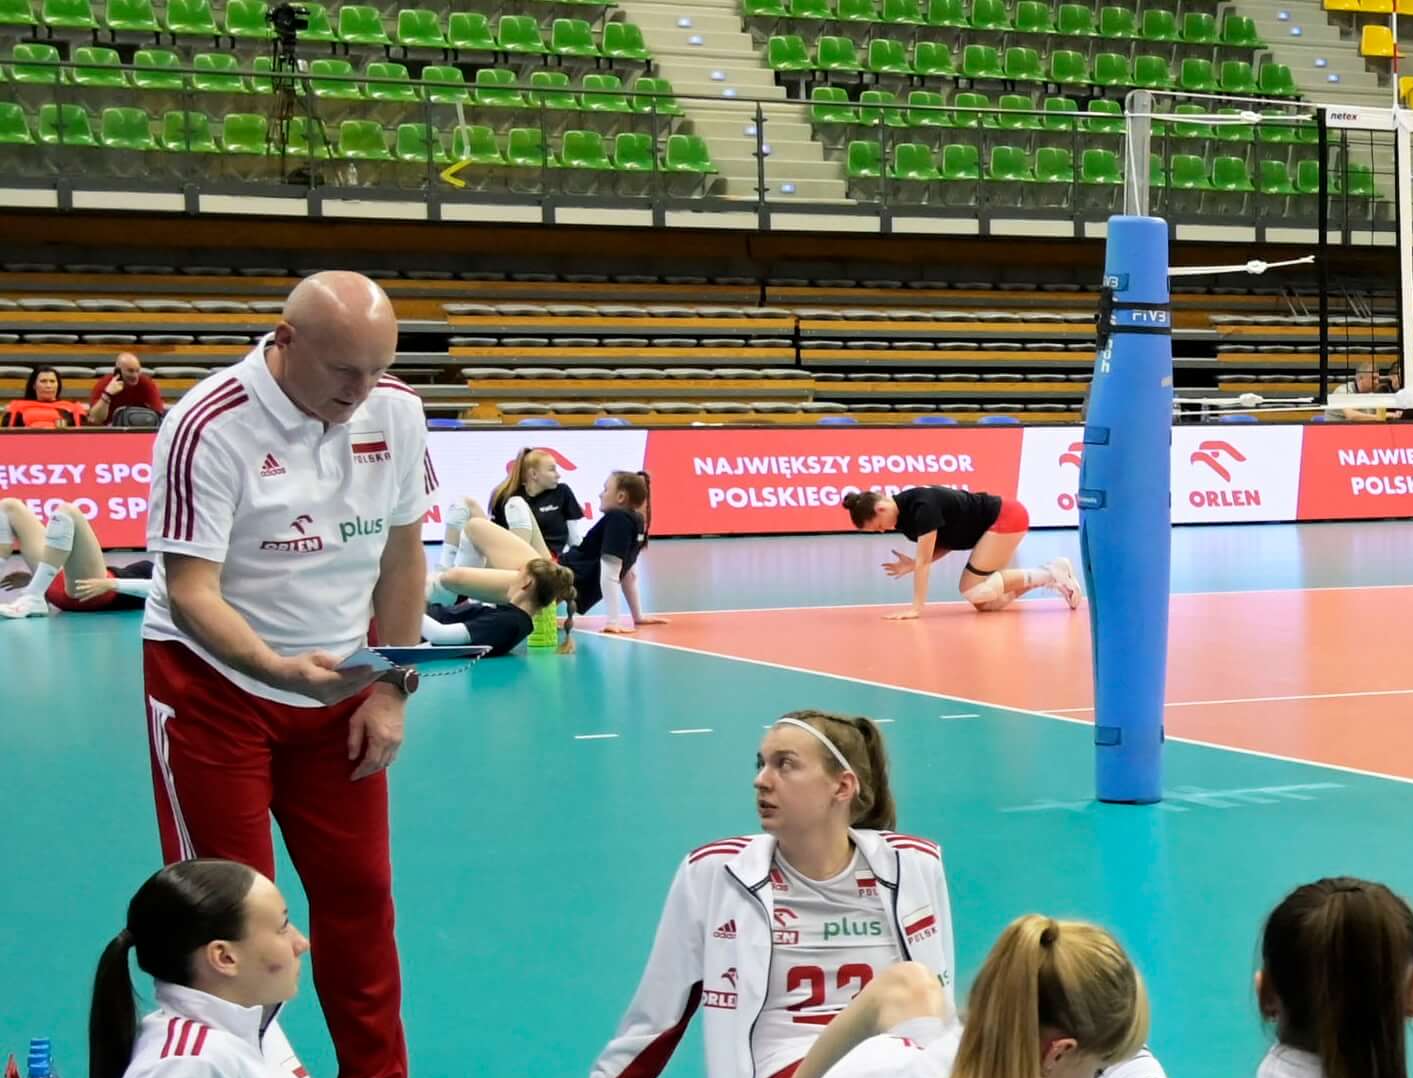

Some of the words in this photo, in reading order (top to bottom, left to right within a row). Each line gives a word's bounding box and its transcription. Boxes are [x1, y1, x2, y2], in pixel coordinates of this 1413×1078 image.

[1330, 112, 1358, 121] netex
[693, 456, 851, 479] NAJWIĘKSZY
[858, 454, 974, 473] SPONSOR
[1189, 490, 1262, 508] ORLEN
[339, 515, 383, 542] plus
[824, 917, 882, 941] plus
